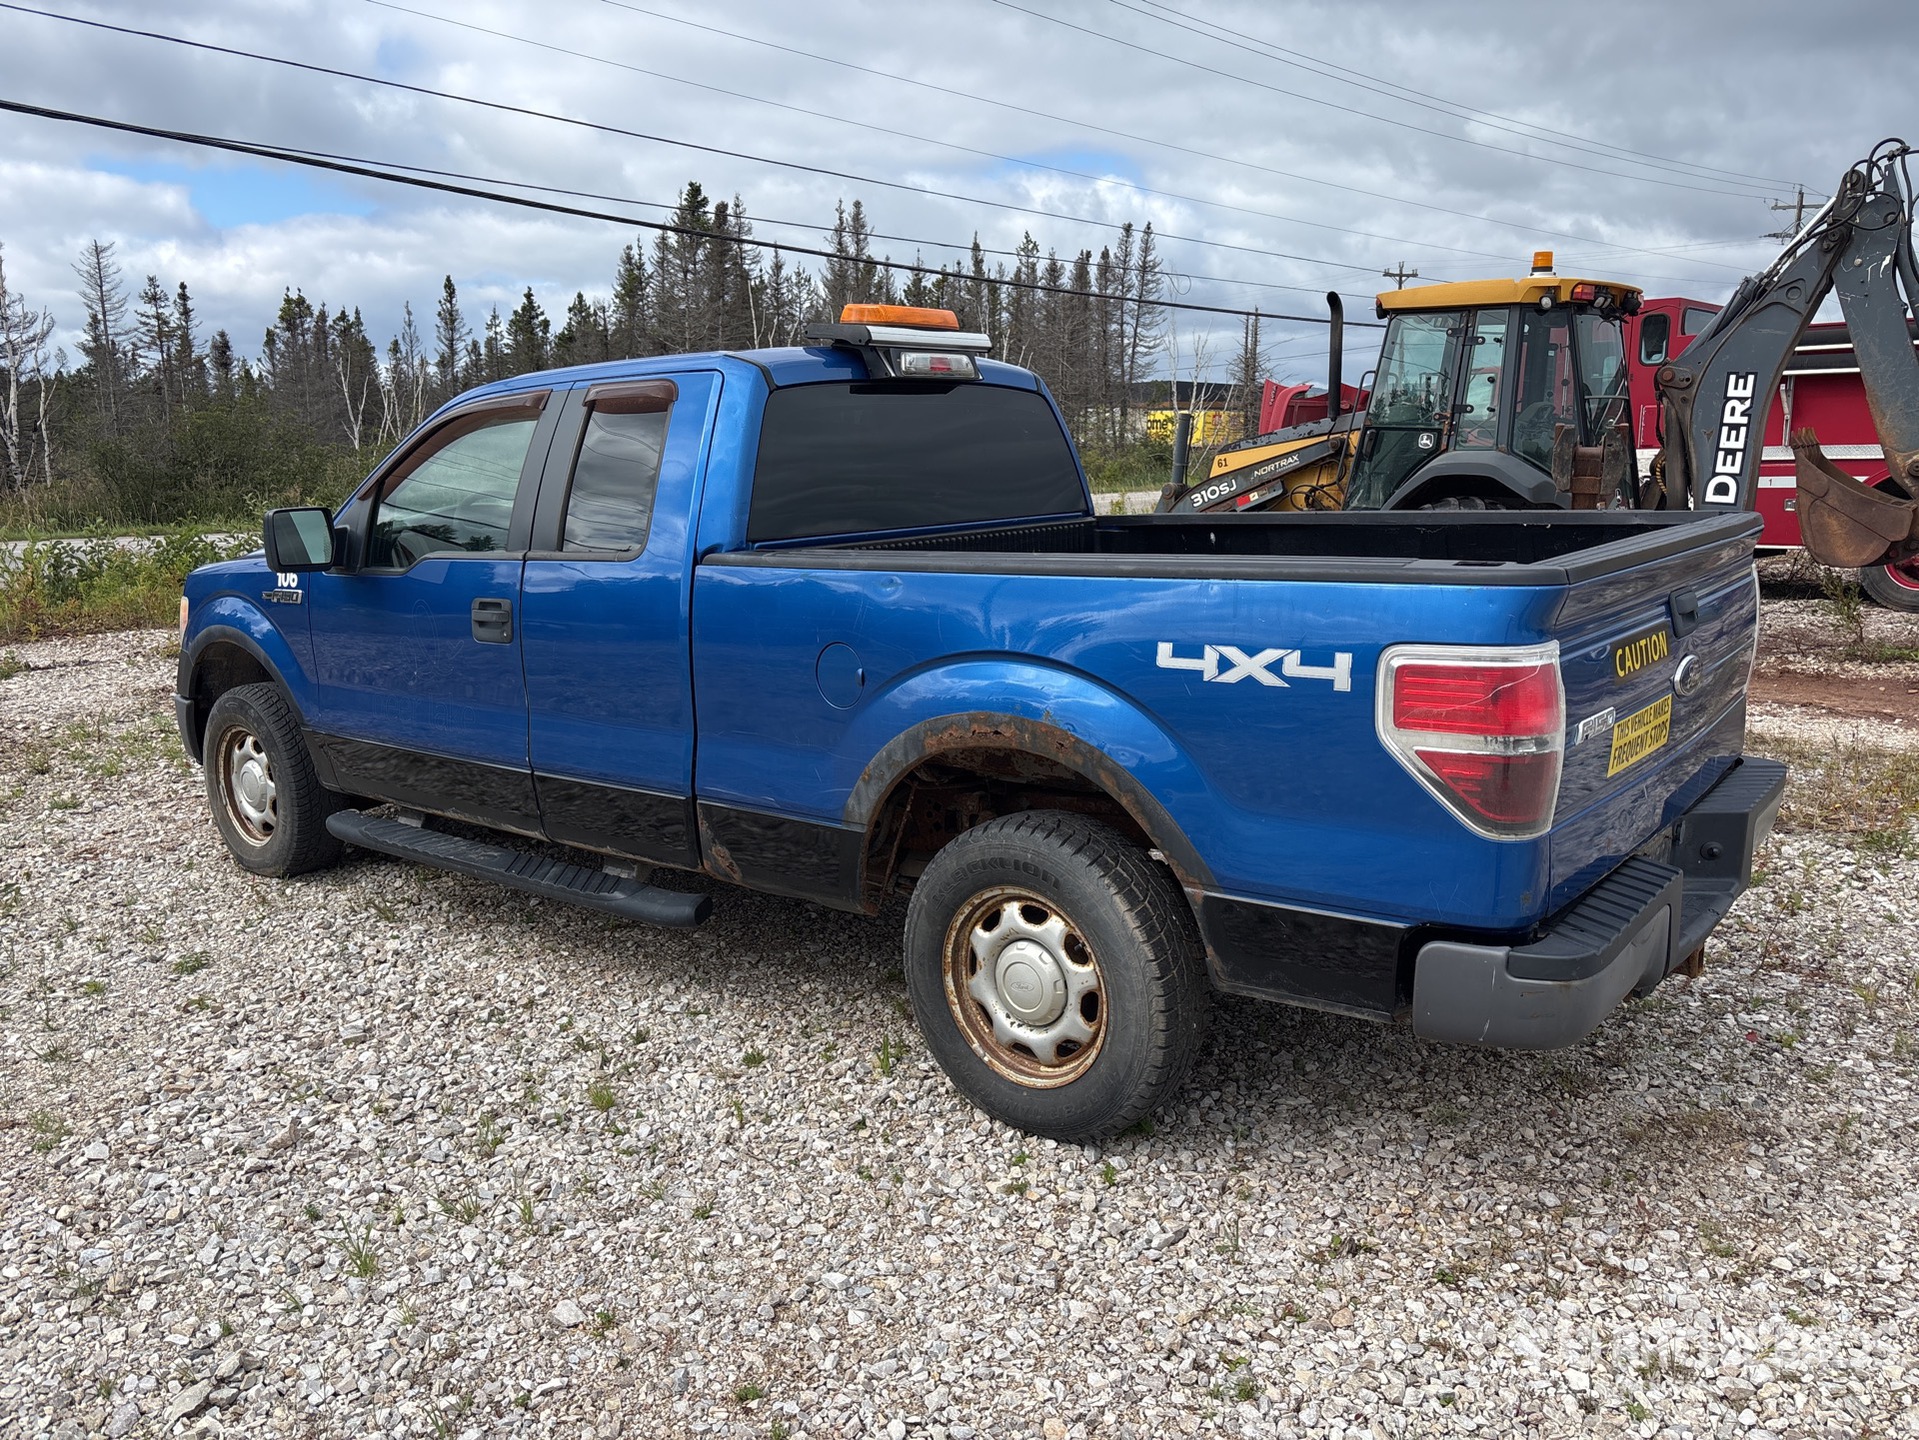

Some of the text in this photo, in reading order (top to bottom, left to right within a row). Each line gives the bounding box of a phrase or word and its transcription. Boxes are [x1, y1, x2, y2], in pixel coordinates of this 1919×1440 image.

[1705, 374, 1755, 504] DEERE
[1217, 458, 1229, 468] 61
[1253, 454, 1300, 477] NORTRAX
[1191, 479, 1237, 507] 310SJ
[1615, 631, 1668, 678] CAUTION
[1616, 696, 1671, 742] THIS VEHICLE MAKES
[1611, 719, 1669, 770] FREQUENT STOPS
